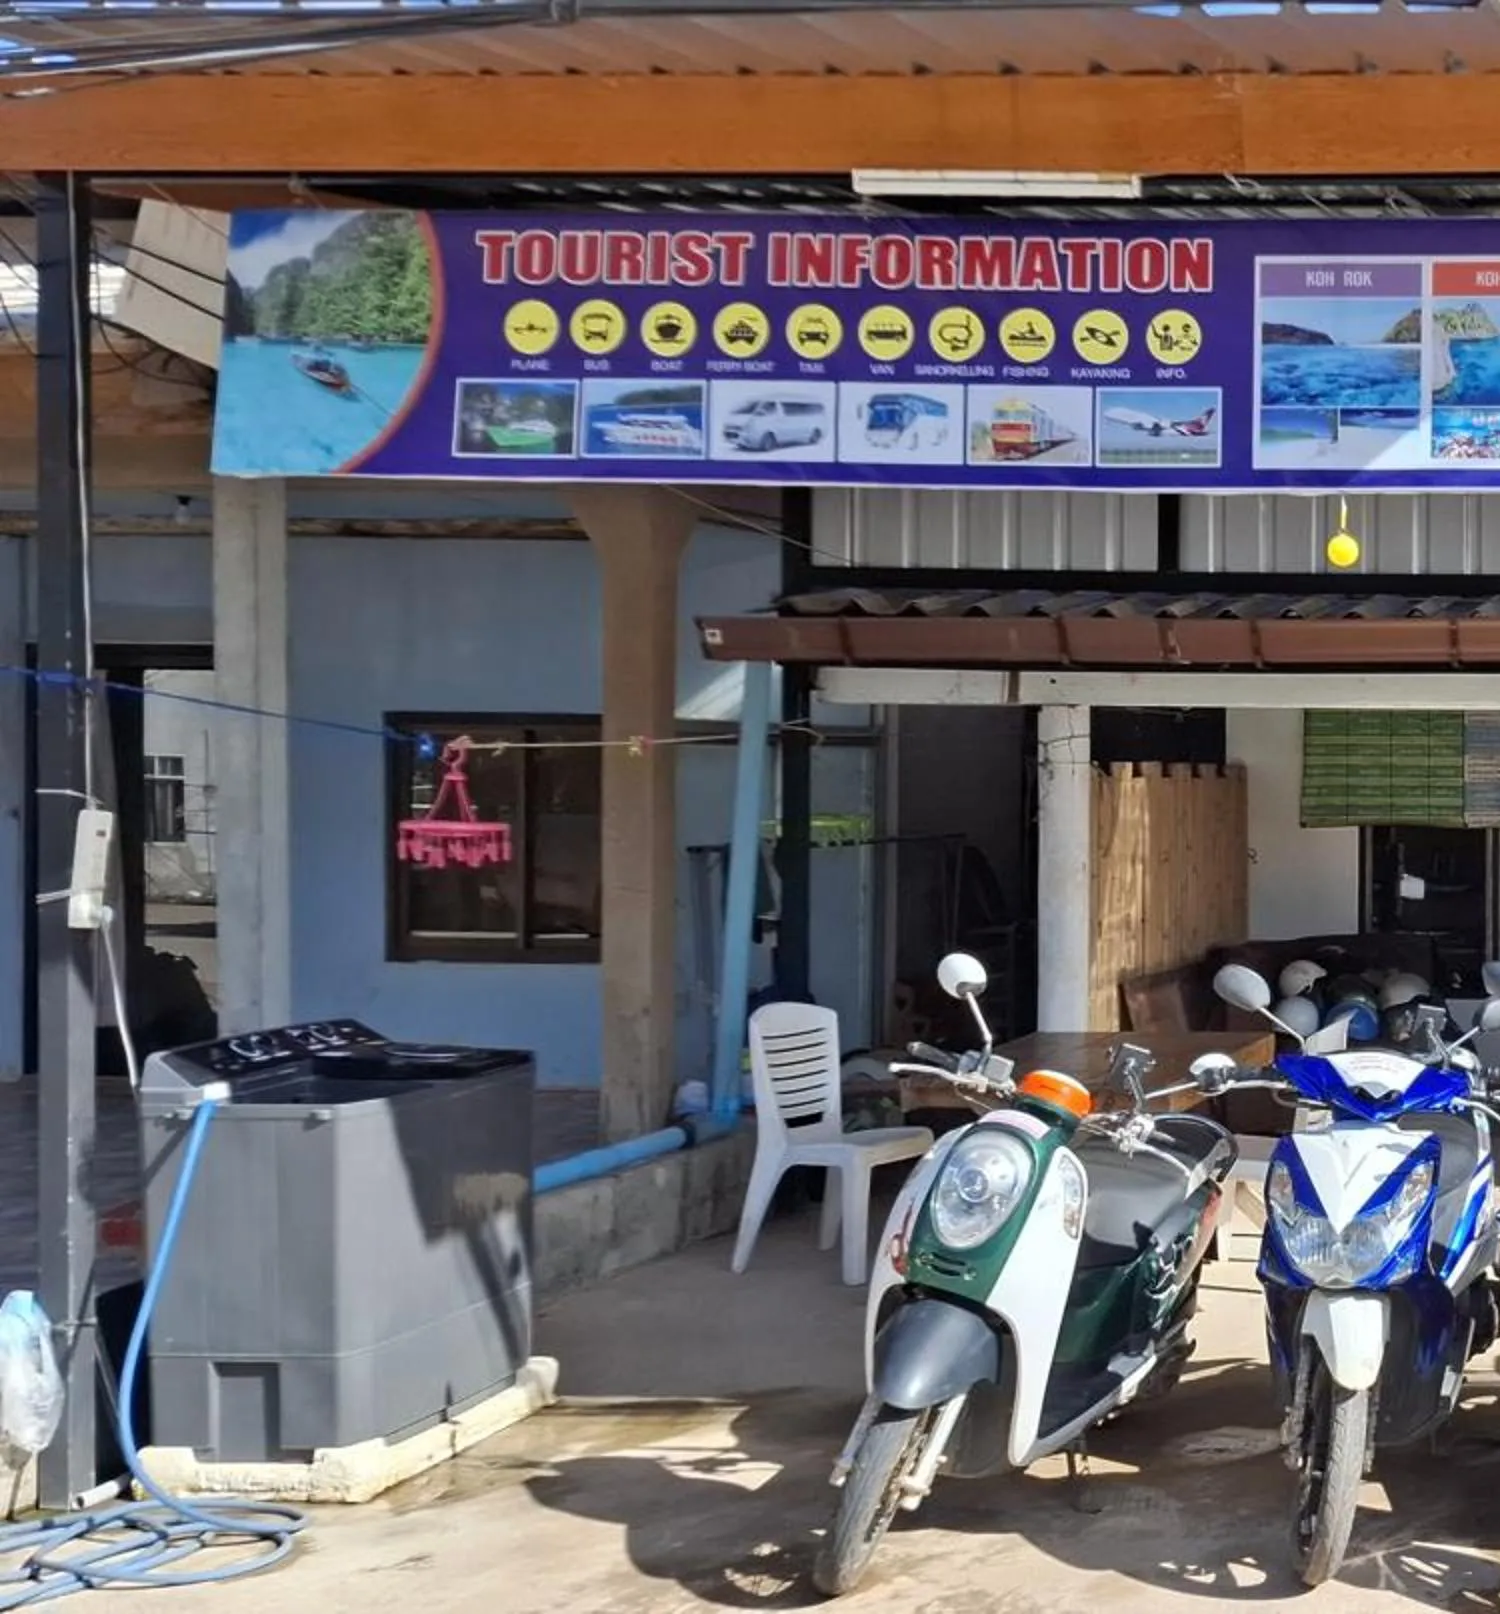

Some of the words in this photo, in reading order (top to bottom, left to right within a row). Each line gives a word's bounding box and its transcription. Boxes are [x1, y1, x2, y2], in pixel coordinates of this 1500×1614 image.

[476, 229, 755, 287] TOURIST
[767, 232, 1213, 294] INFORMATION
[1305, 270, 1335, 288] KOH
[1343, 270, 1372, 287] ROK
[651, 360, 683, 371] BOAT
[869, 364, 895, 376] VAN
[1071, 367, 1131, 379] KAYAKING
